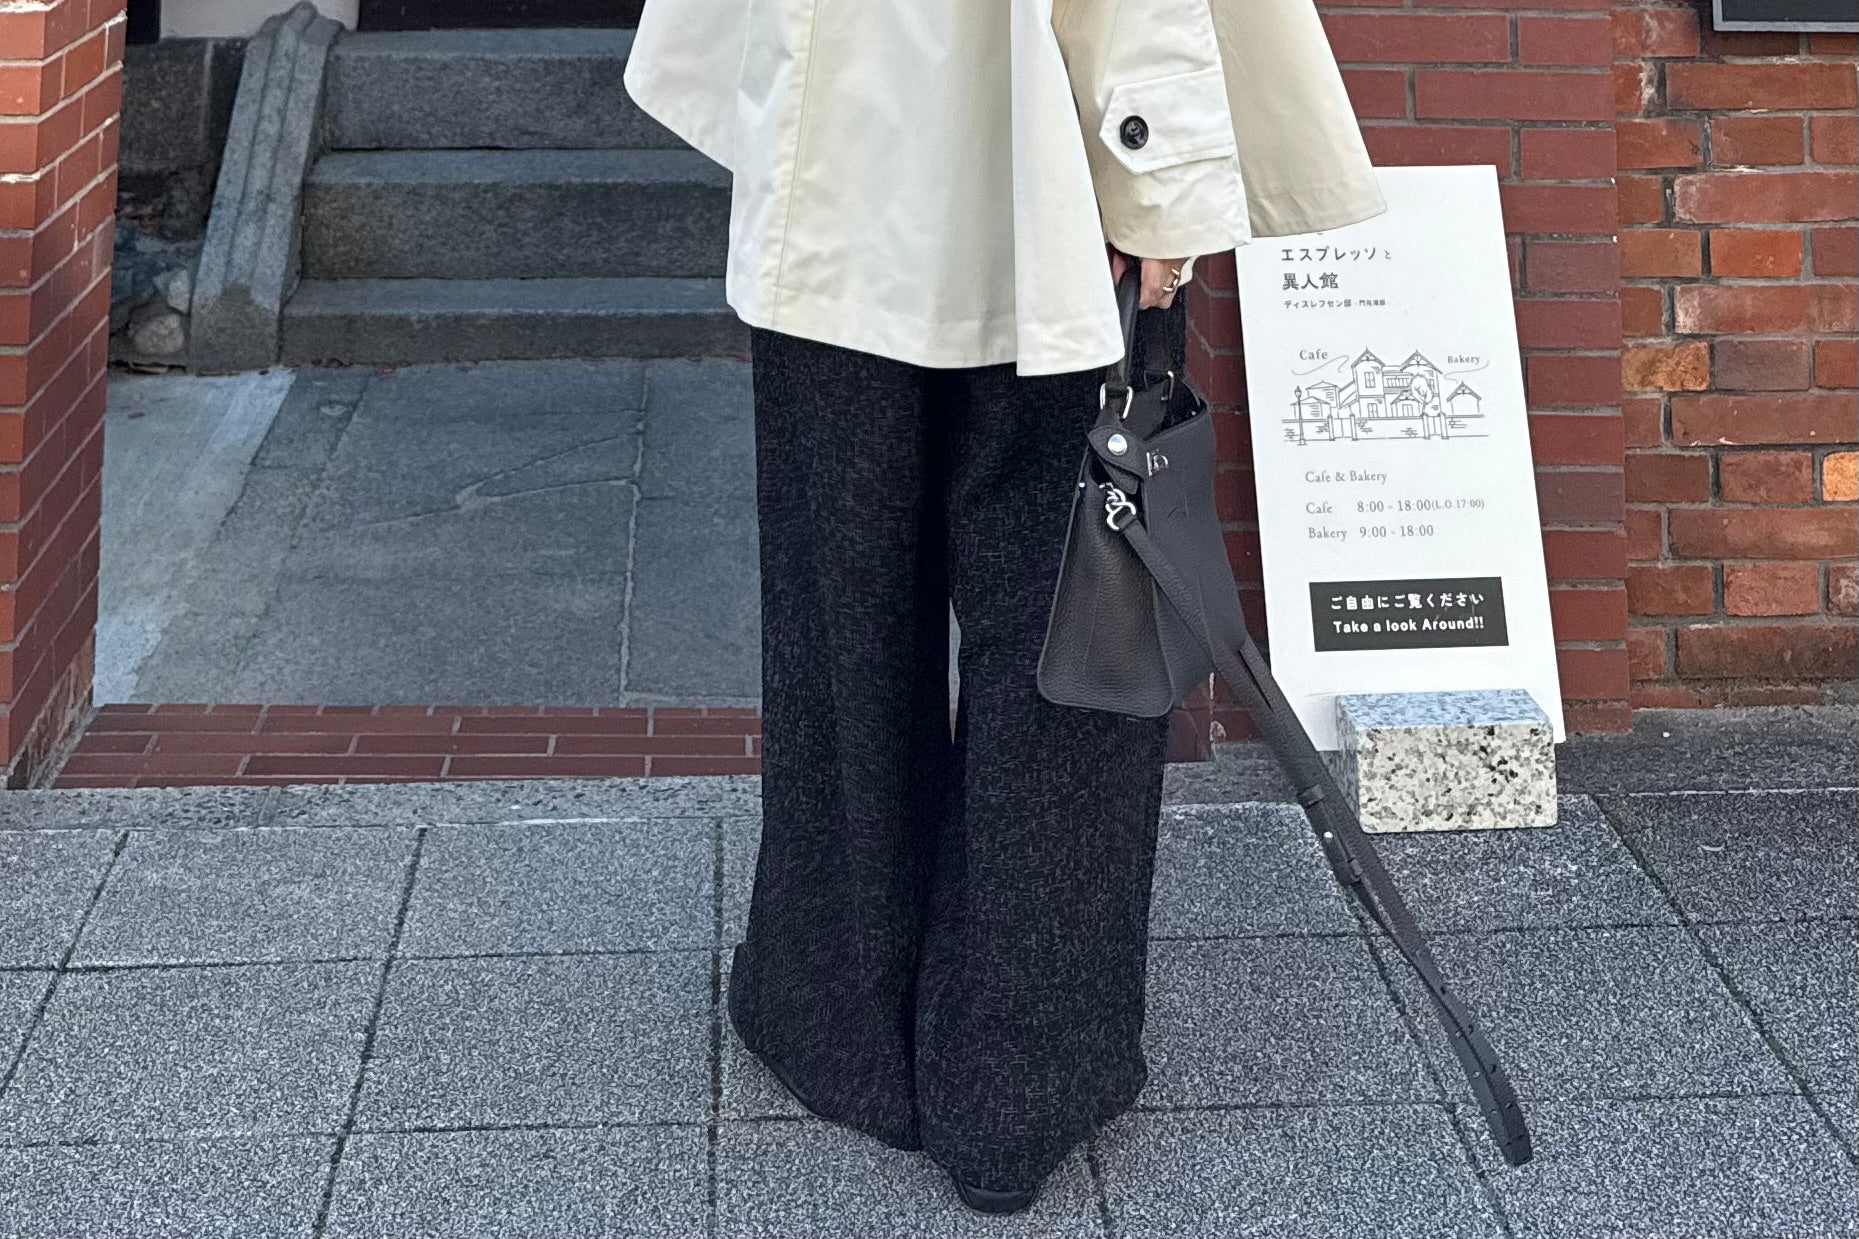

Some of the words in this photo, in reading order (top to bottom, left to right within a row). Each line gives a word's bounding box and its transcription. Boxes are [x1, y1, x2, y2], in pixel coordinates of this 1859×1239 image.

[1282, 272, 1339, 290] 異人館
[1299, 349, 1328, 361] Cafe
[1446, 355, 1481, 365] Bakery
[1304, 471, 1331, 483] Cafe
[1335, 472, 1346, 482] &
[1349, 470, 1388, 485] Bakery
[1305, 501, 1333, 514] Cafe
[1357, 501, 1384, 513] 8:00
[1308, 527, 1347, 542] Bakery
[1359, 526, 1387, 538] 9:00
[1400, 525, 1434, 537] 18:00
[1330, 592, 1485, 610] ご自由にご覧ください
[1333, 620, 1369, 634] Take
[1373, 623, 1382, 632] a
[1386, 619, 1418, 632] look
[1422, 616, 1485, 631] Around!!
